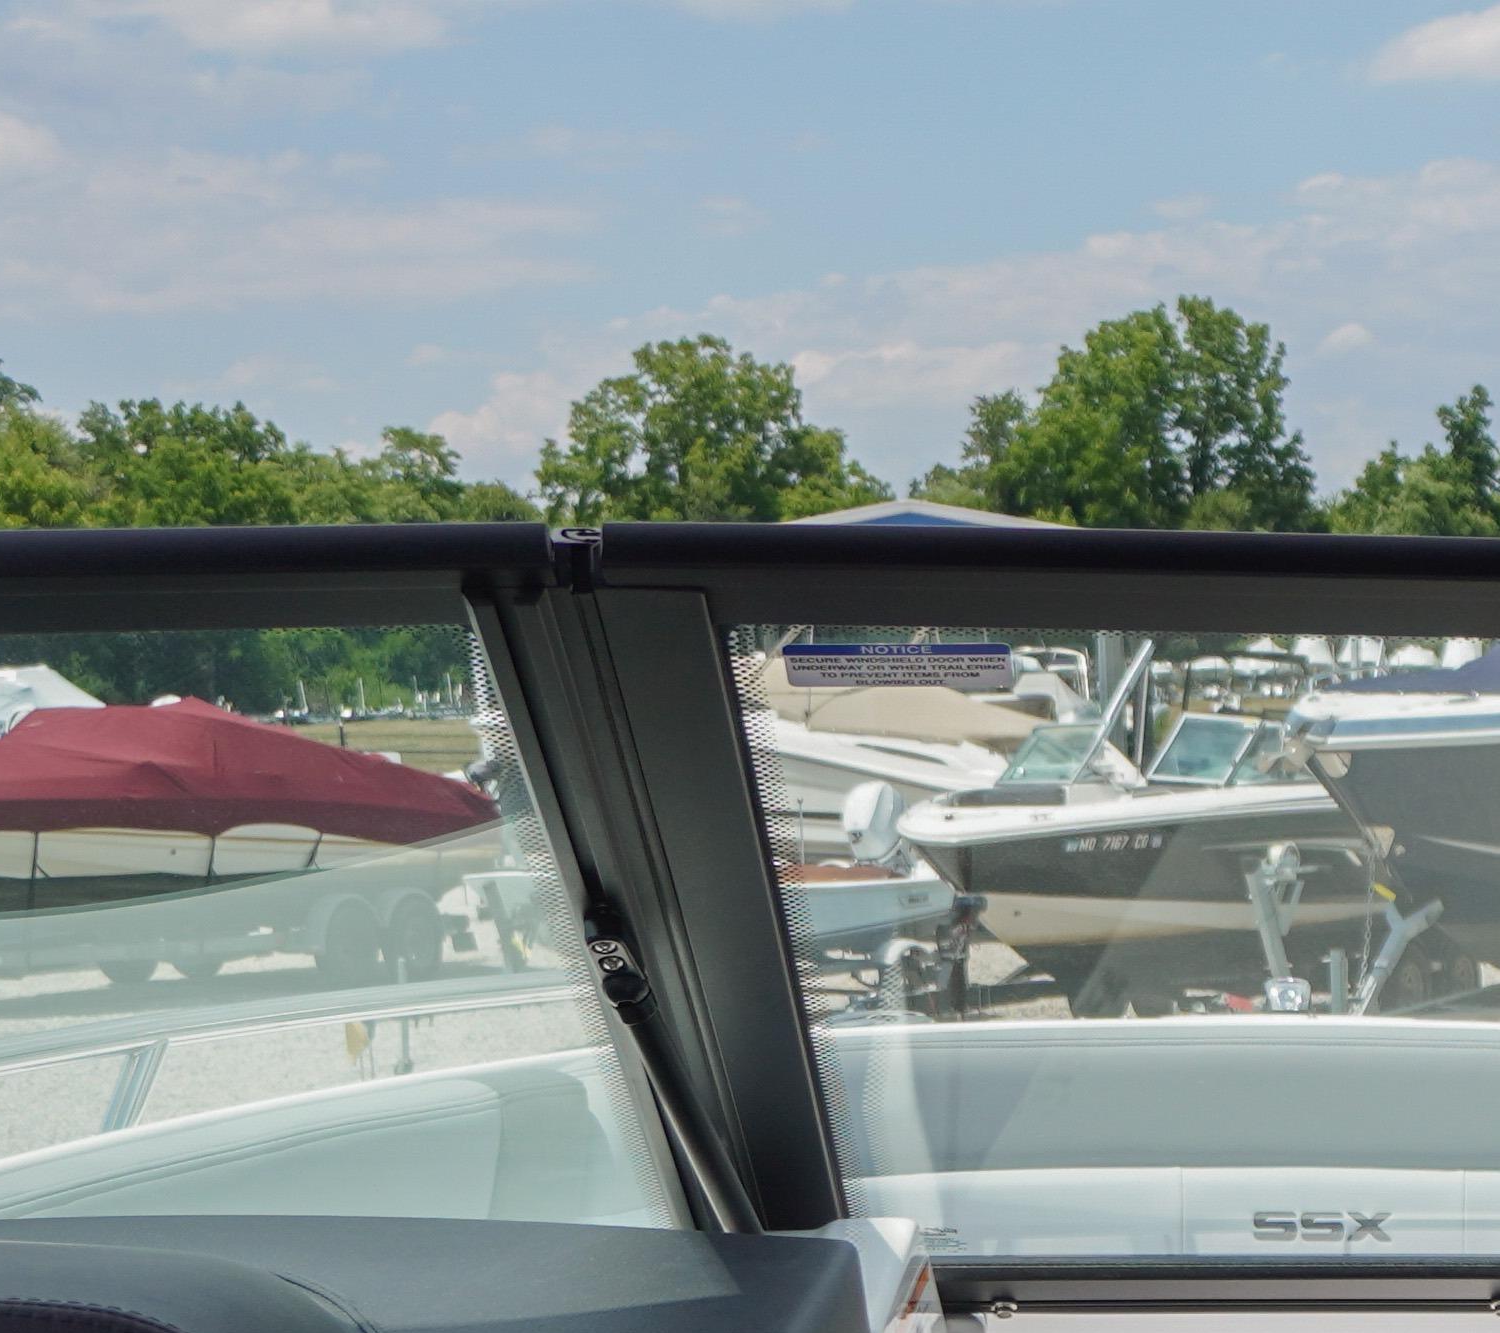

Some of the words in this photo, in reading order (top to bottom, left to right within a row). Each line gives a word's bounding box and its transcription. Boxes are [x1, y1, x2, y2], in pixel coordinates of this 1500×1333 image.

[861, 645, 931, 654] NOTICE
[789, 656, 840, 664] SECURE
[845, 656, 923, 664] WINDSHIELD
[855, 678, 914, 686] BLOWING
[1252, 1210, 1392, 1242] SSX
